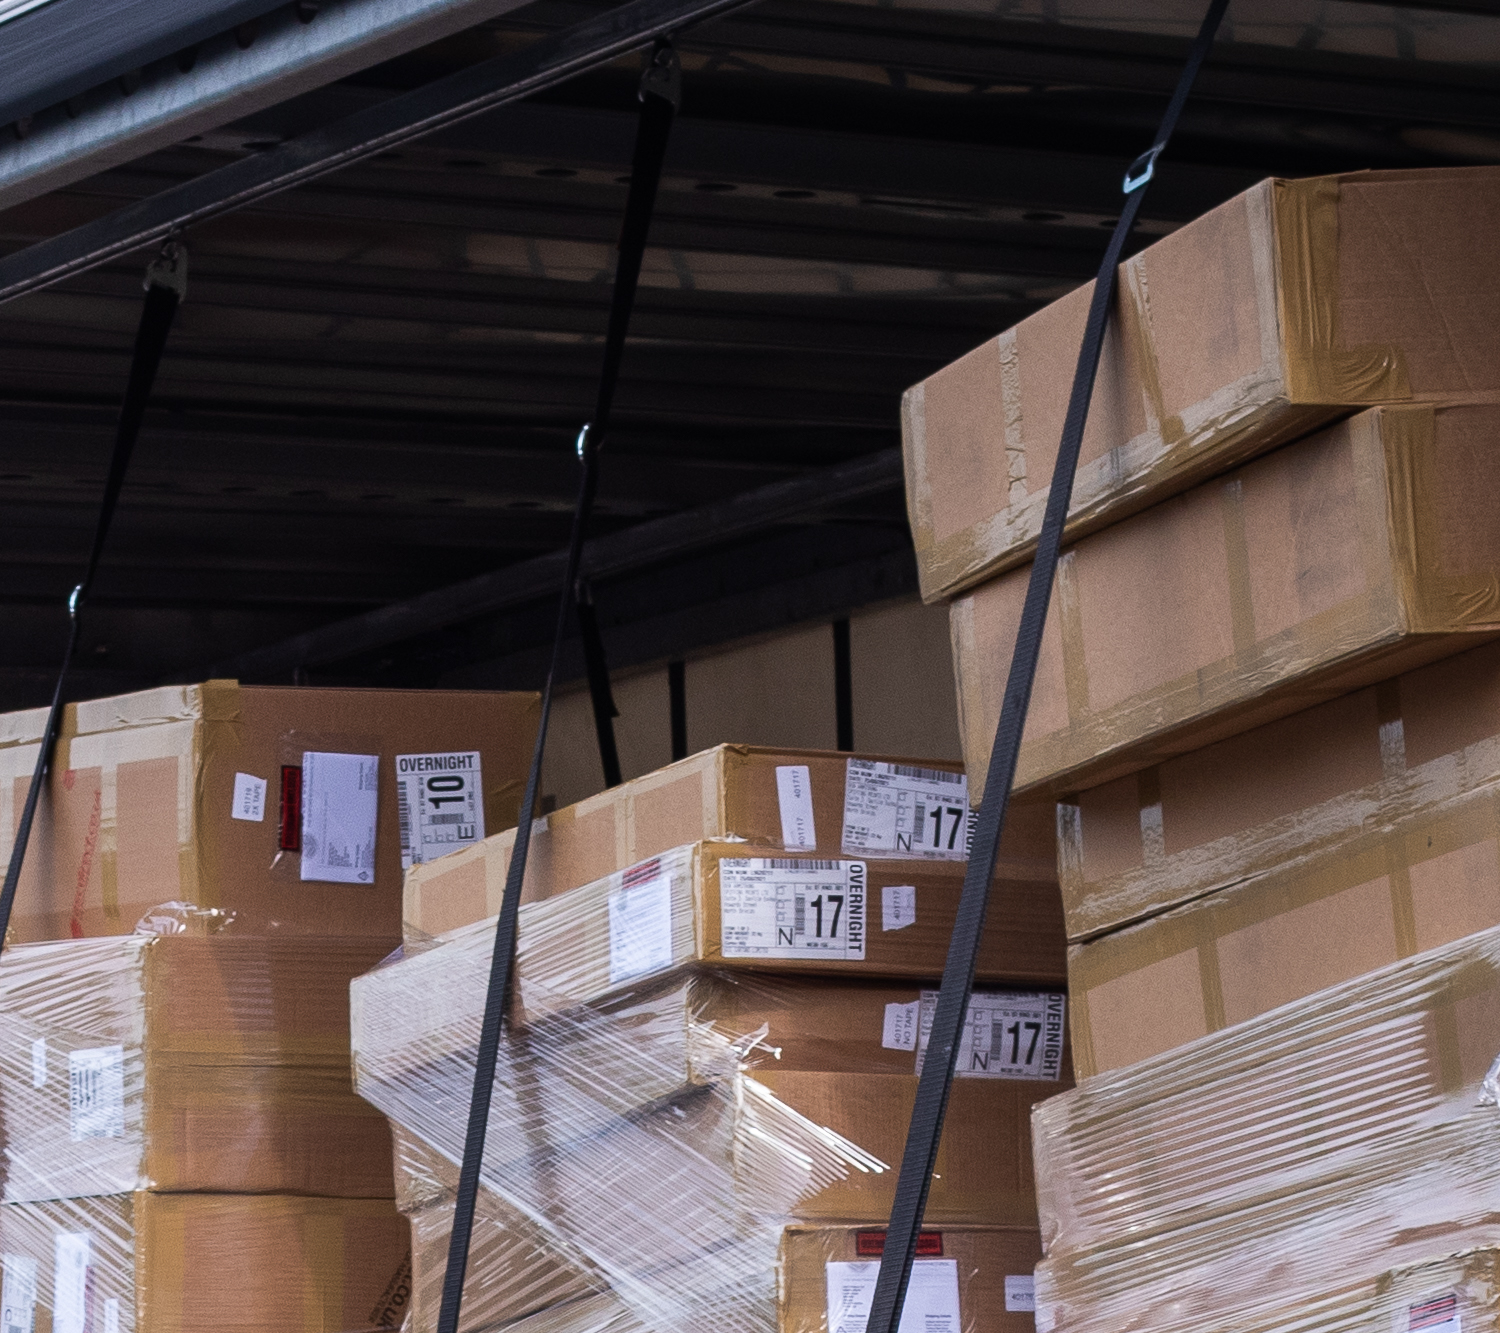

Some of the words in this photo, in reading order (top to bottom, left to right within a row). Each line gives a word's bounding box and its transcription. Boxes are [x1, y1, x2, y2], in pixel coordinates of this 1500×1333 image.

[399, 755, 475, 773] OVERNIGHT
[252, 782, 261, 801] TAPE
[426, 775, 465, 810] 10
[792, 769, 801, 799] 401717
[457, 824, 475, 841] E
[896, 832, 912, 852] N
[929, 805, 964, 850] 17
[810, 894, 845, 939] 17
[848, 863, 864, 954] OVERNIGHT
[893, 889, 902, 921] 401717
[777, 927, 794, 946] N
[894, 1014, 904, 1045] 401717
[904, 1006, 915, 1029] TAPE
[1007, 1020, 1042, 1066] 17
[1042, 994, 1063, 1080] OVERNIGHT
[972, 1052, 989, 1071] N
